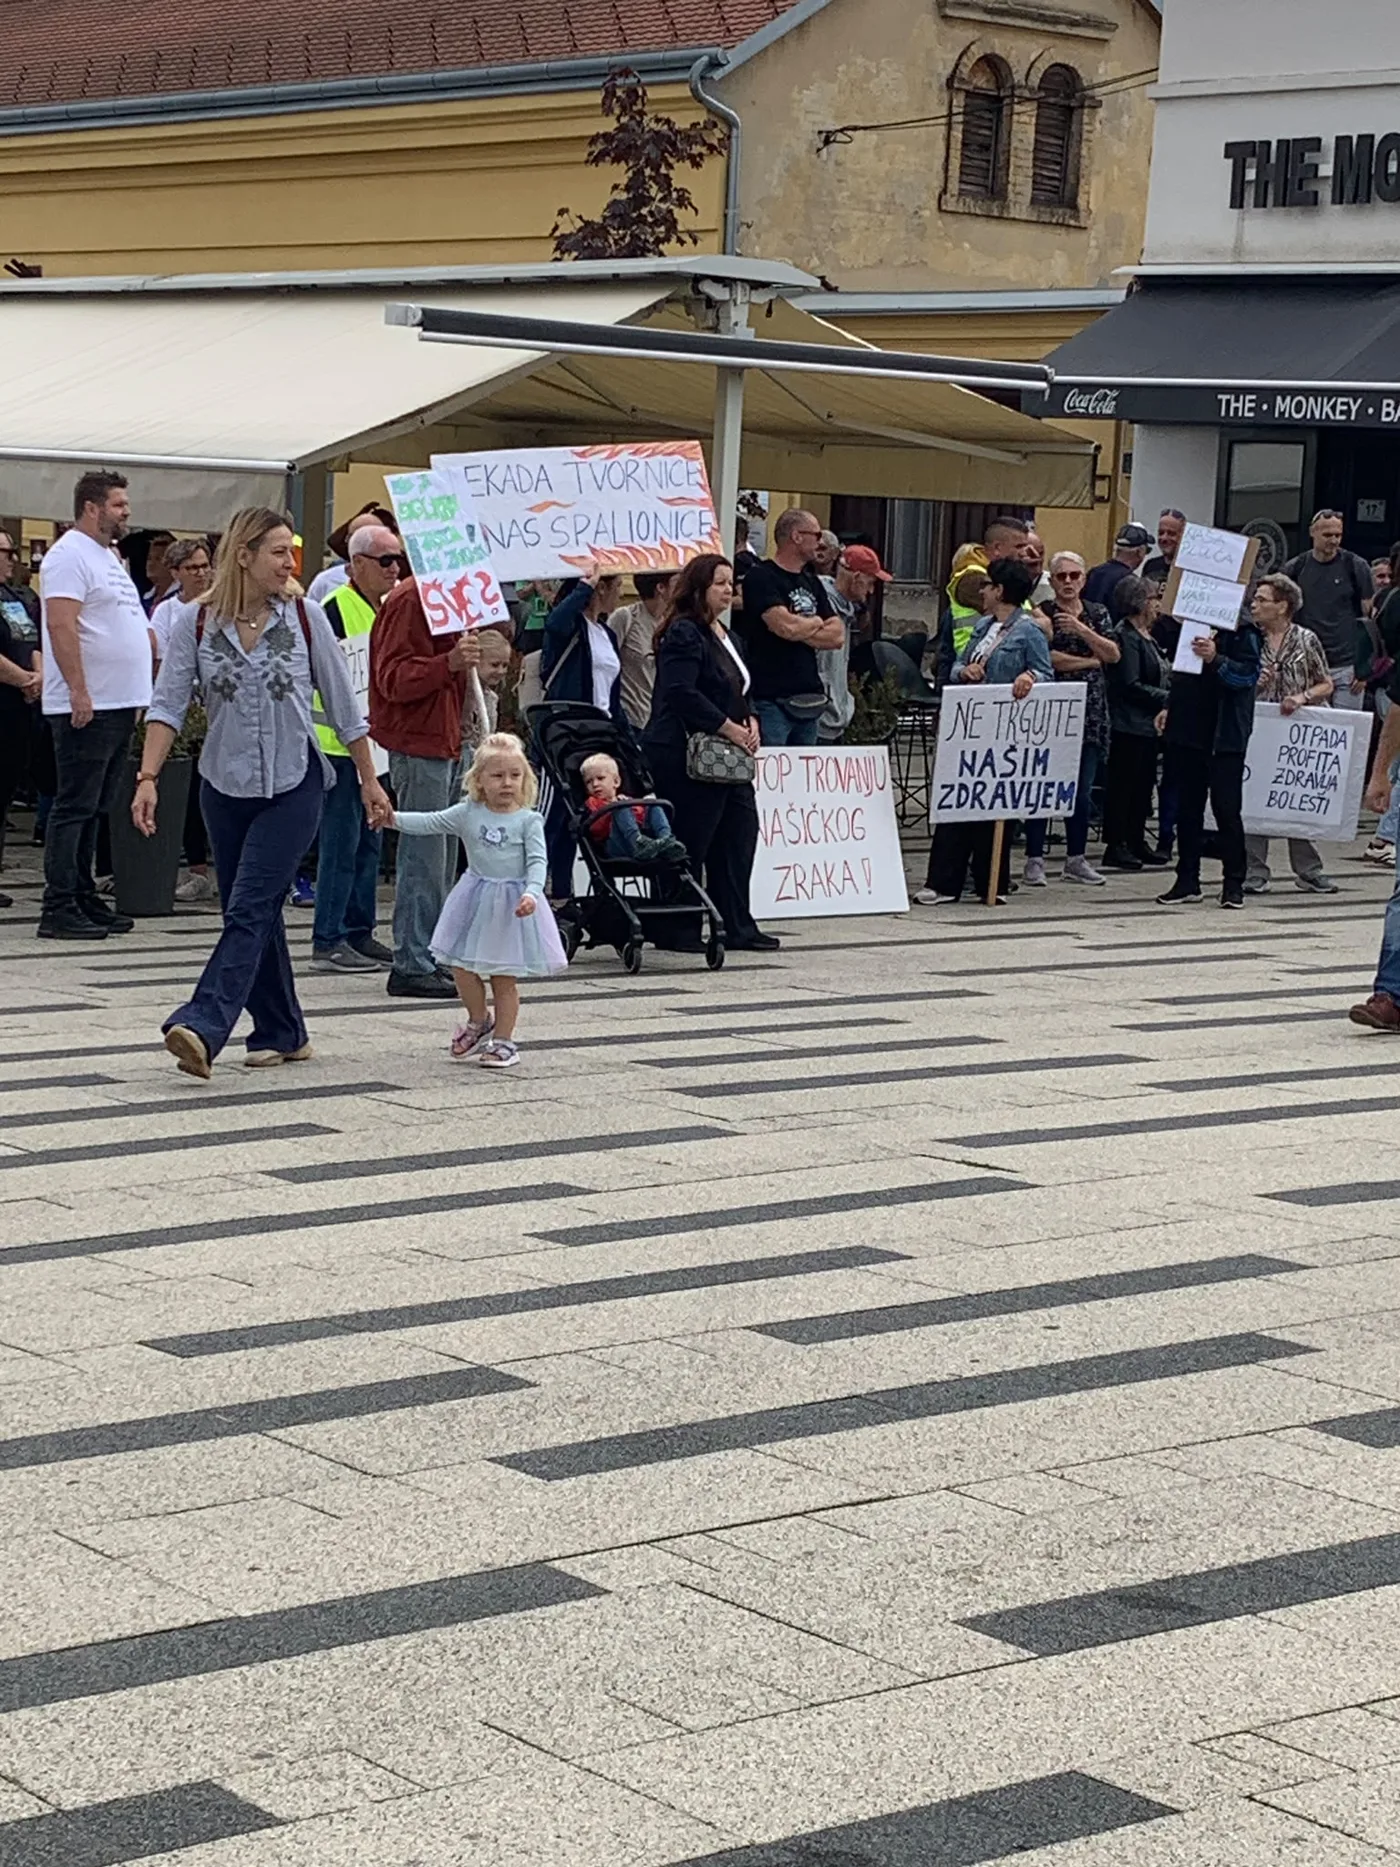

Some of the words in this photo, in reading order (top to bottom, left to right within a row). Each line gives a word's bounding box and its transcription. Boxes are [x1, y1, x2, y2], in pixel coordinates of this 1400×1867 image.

[1224, 137, 1322, 209] THE
[1217, 394, 1257, 417] THE
[1274, 395, 1363, 421] MONKEY
[464, 464, 553, 497] EKADA
[562, 459, 701, 494] TVORNICE
[1366, 504, 1378, 517] 17
[479, 517, 541, 554] NAS
[550, 509, 713, 549] SPALIONICE
[945, 698, 985, 742] NE
[992, 699, 1082, 746] TRGUJTE
[1289, 723, 1348, 750] OTPADA
[754, 753, 793, 794] TOP
[798, 755, 888, 798] TROVANJU
[958, 744, 1051, 778] NAŠIM
[1277, 745, 1341, 774] PROFITA
[937, 780, 1077, 816] ZDRAVLJEM
